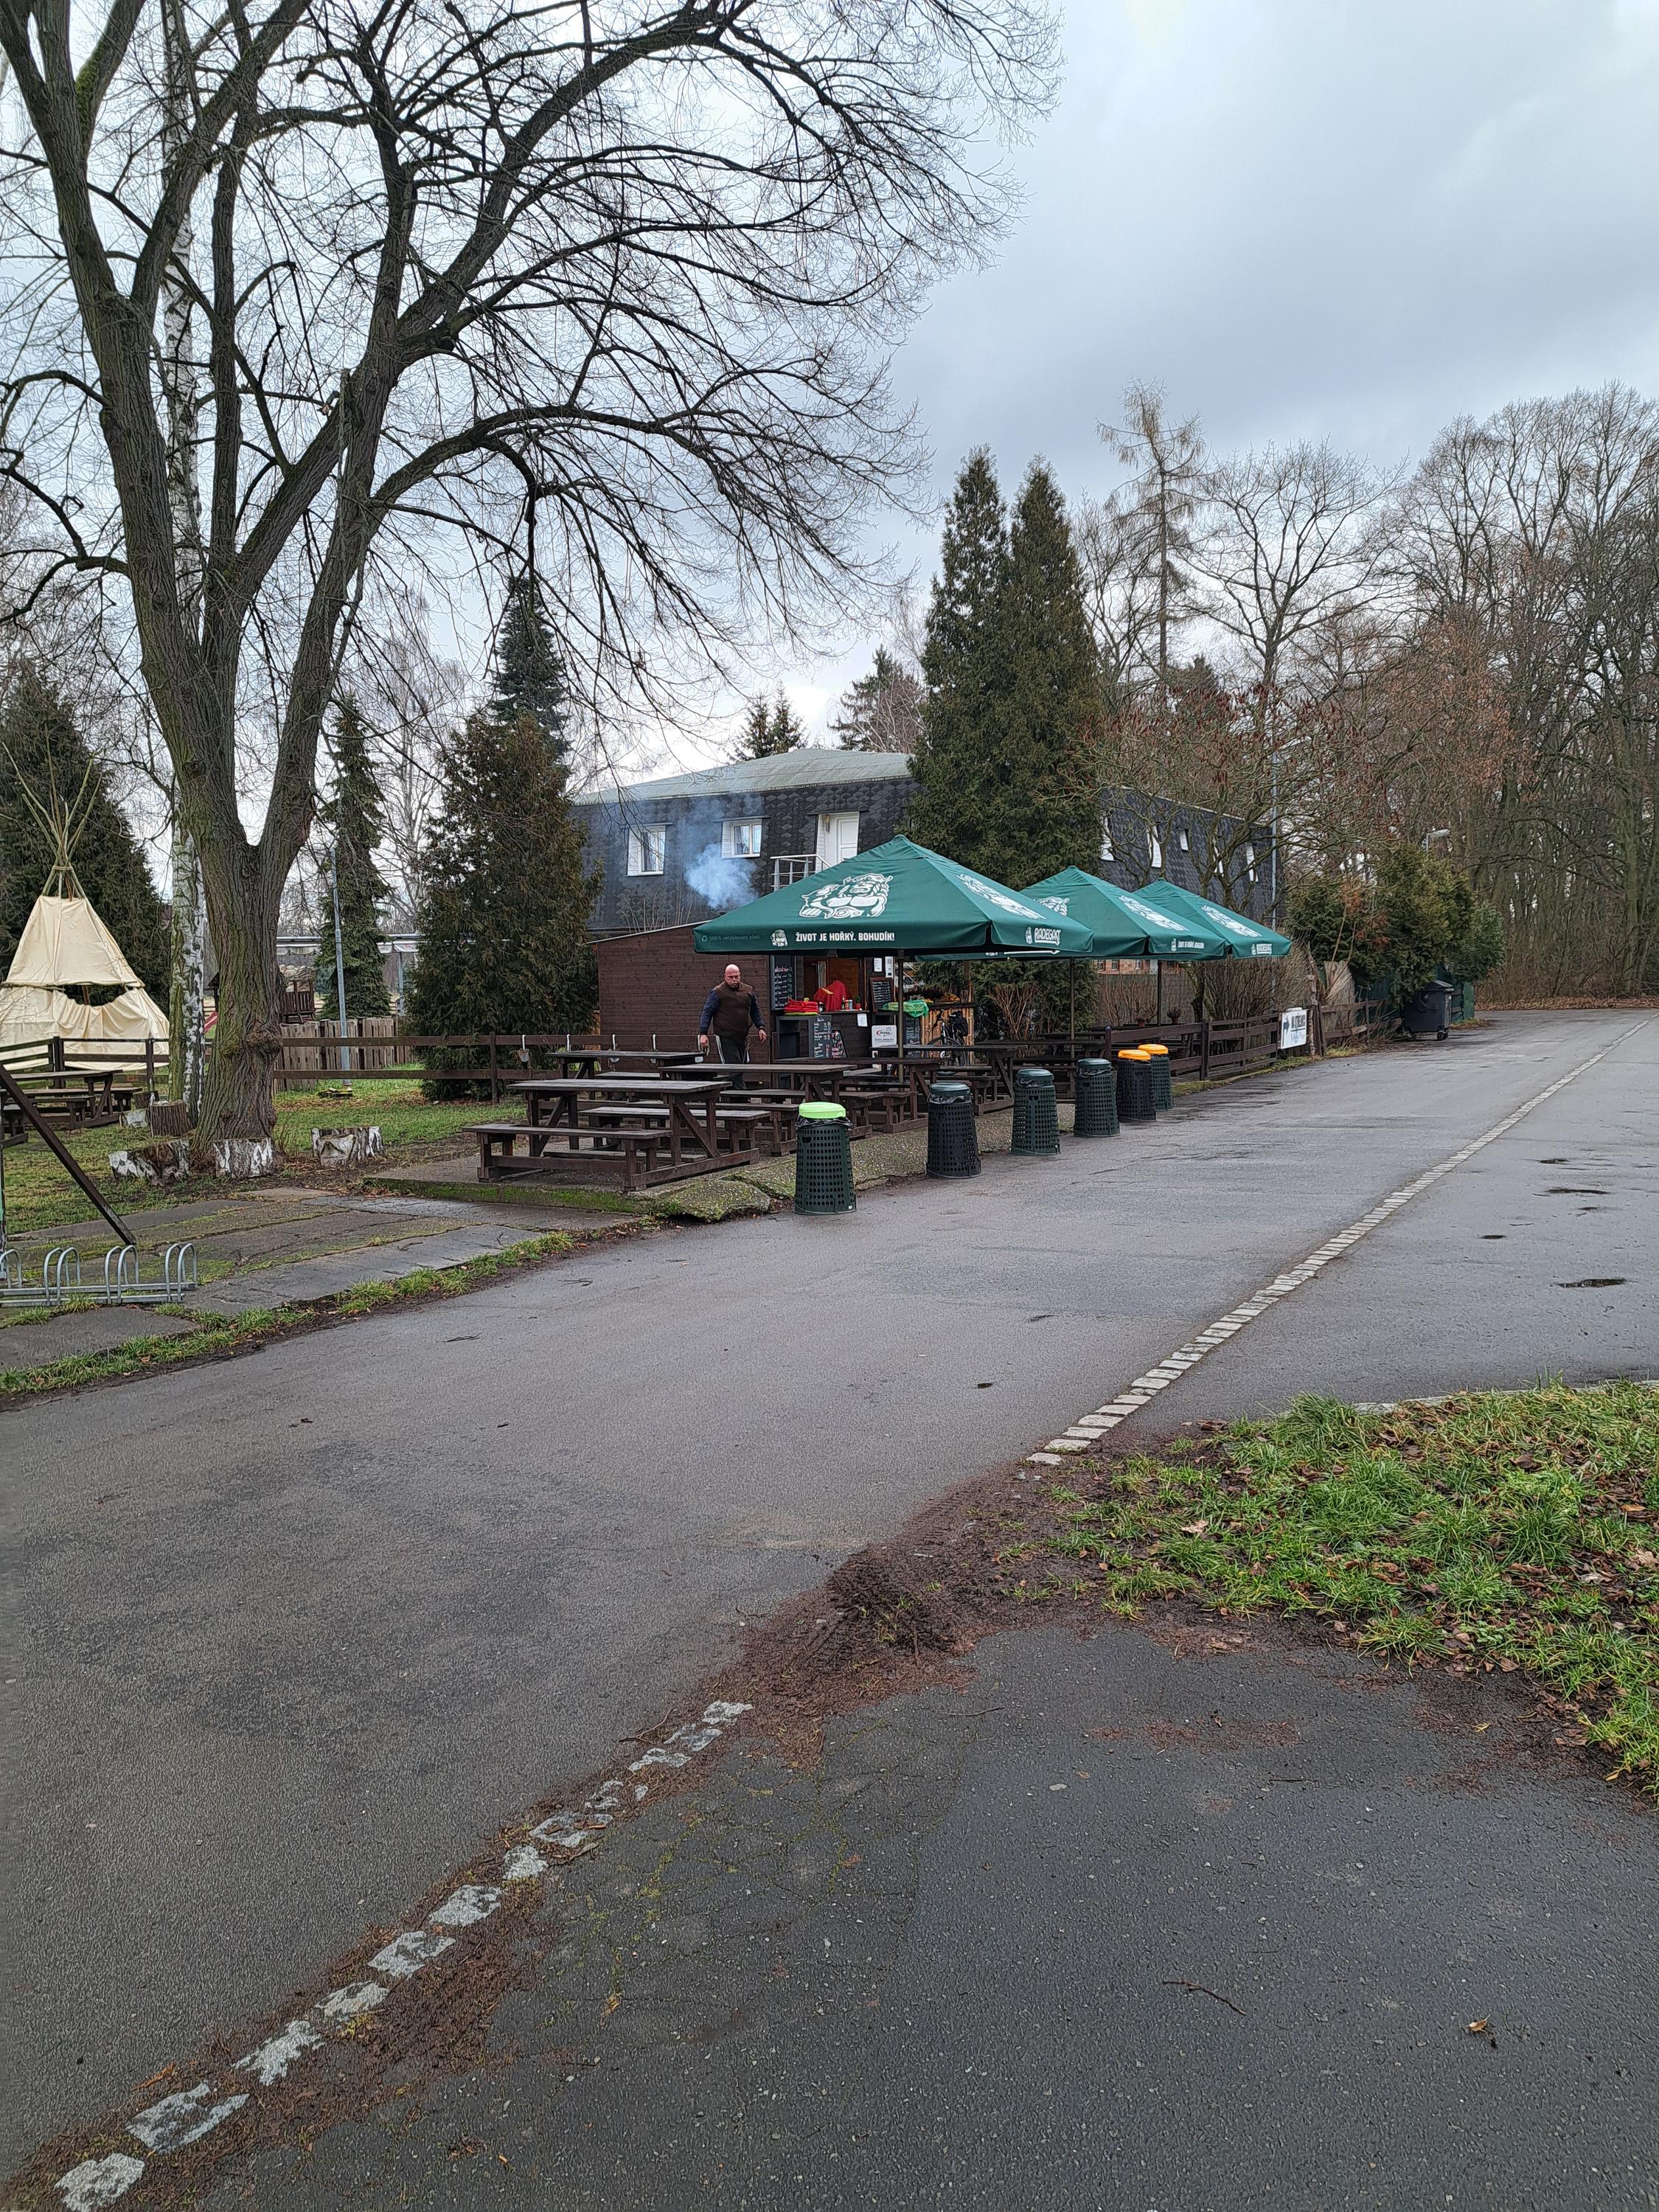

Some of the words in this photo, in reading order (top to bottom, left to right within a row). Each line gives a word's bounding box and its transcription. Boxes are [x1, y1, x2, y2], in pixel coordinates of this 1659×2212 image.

[796, 932, 817, 942] ŽIVOT
[819, 933, 827, 942] JE
[830, 931, 856, 942] HOŘKÝ.
[858, 931, 895, 942] BOHUDÍK!
[1034, 928, 1061, 945] RADEGAST
